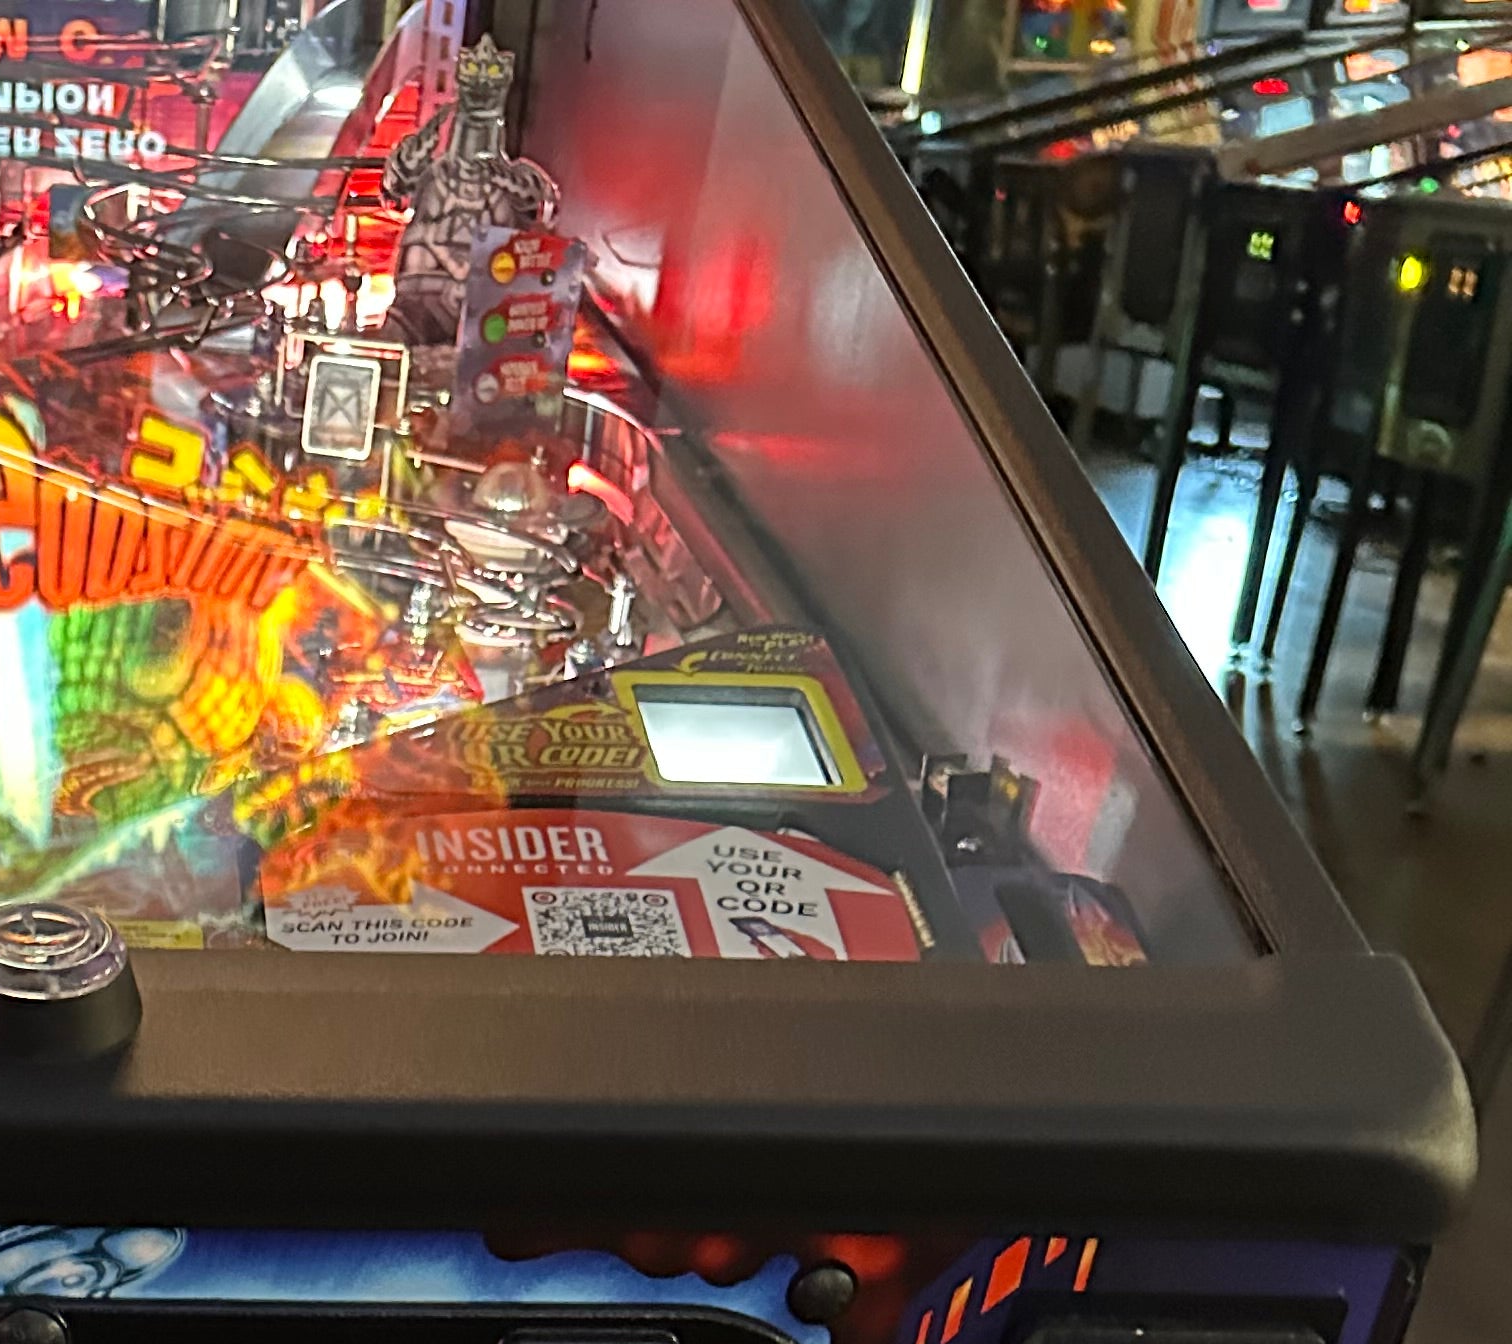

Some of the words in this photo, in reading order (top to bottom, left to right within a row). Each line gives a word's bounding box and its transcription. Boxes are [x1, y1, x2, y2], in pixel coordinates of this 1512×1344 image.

[540, 721, 632, 743] YOUR
[539, 746, 643, 767] CODE!
[416, 826, 610, 863] INSIDER
[713, 844, 784, 864] USE
[420, 864, 614, 876] CONNECTED
[705, 859, 802, 881] YOUR
[736, 879, 785, 898] QR
[716, 896, 818, 918] CODE
[282, 919, 343, 933] SCAN
[354, 919, 405, 933] THIS
[412, 917, 473, 930] CODE
[332, 933, 361, 945] TO
[367, 931, 429, 944] JOIN!
